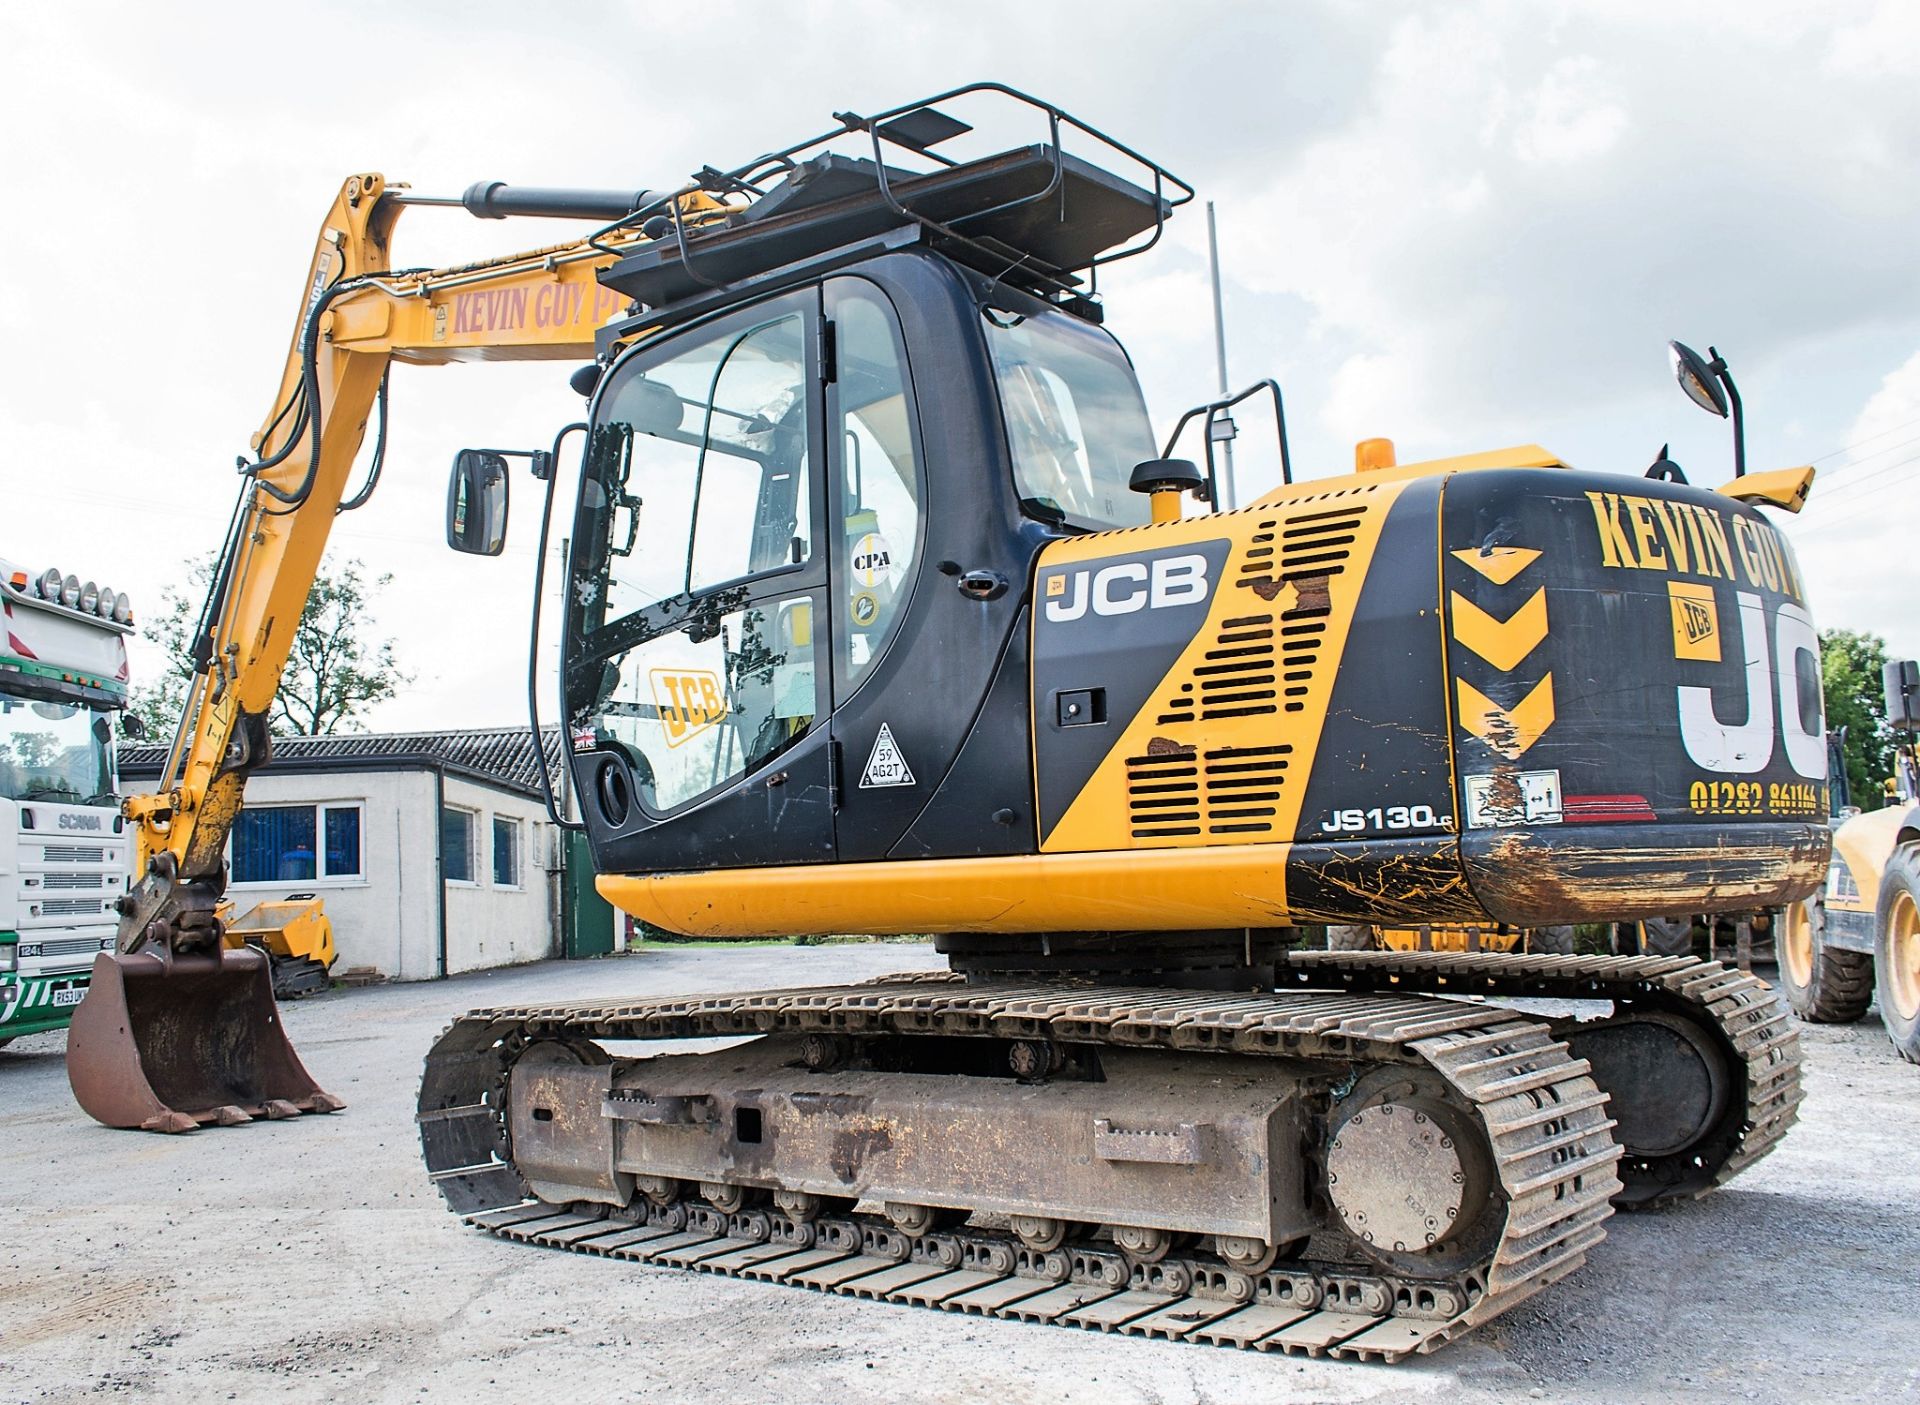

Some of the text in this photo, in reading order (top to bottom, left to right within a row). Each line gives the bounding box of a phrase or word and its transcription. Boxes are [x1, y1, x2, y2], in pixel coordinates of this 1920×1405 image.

[453, 287, 529, 334] KEVIN
[535, 281, 588, 328] GUY
[1584, 491, 1736, 581] KEVIN
[853, 551, 891, 570] CPA
[1045, 554, 1209, 623] JCB
[1683, 602, 1714, 639] JCB
[662, 676, 721, 738] JCB
[873, 763, 899, 778] AG2T
[879, 748, 893, 761] 59
[1689, 781, 1763, 815] 01282
[1769, 782, 1817, 815] 861166
[58, 813, 102, 830] SCANIA
